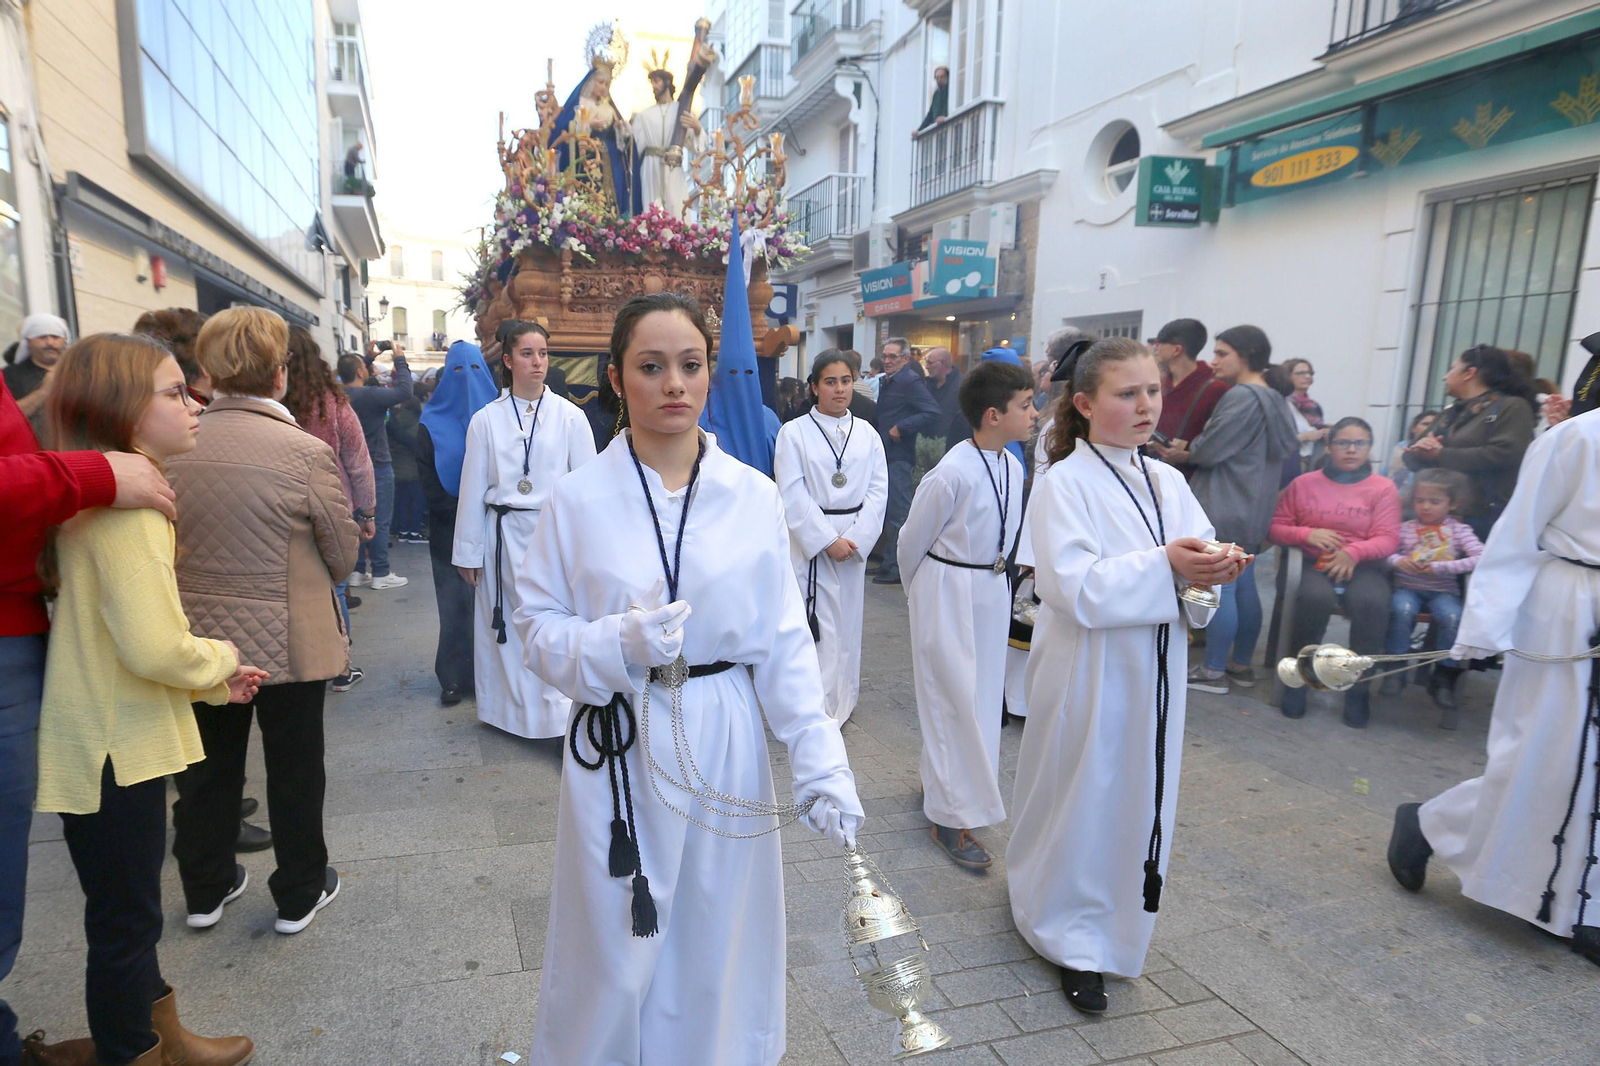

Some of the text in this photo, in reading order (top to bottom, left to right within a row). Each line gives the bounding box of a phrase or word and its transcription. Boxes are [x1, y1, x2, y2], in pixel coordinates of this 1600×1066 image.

[1263, 149, 1342, 185] 901 111 333
[1152, 184, 1198, 196] CAJA RURAL
[943, 245, 985, 256] VISION
[863, 276, 893, 293] VISION
